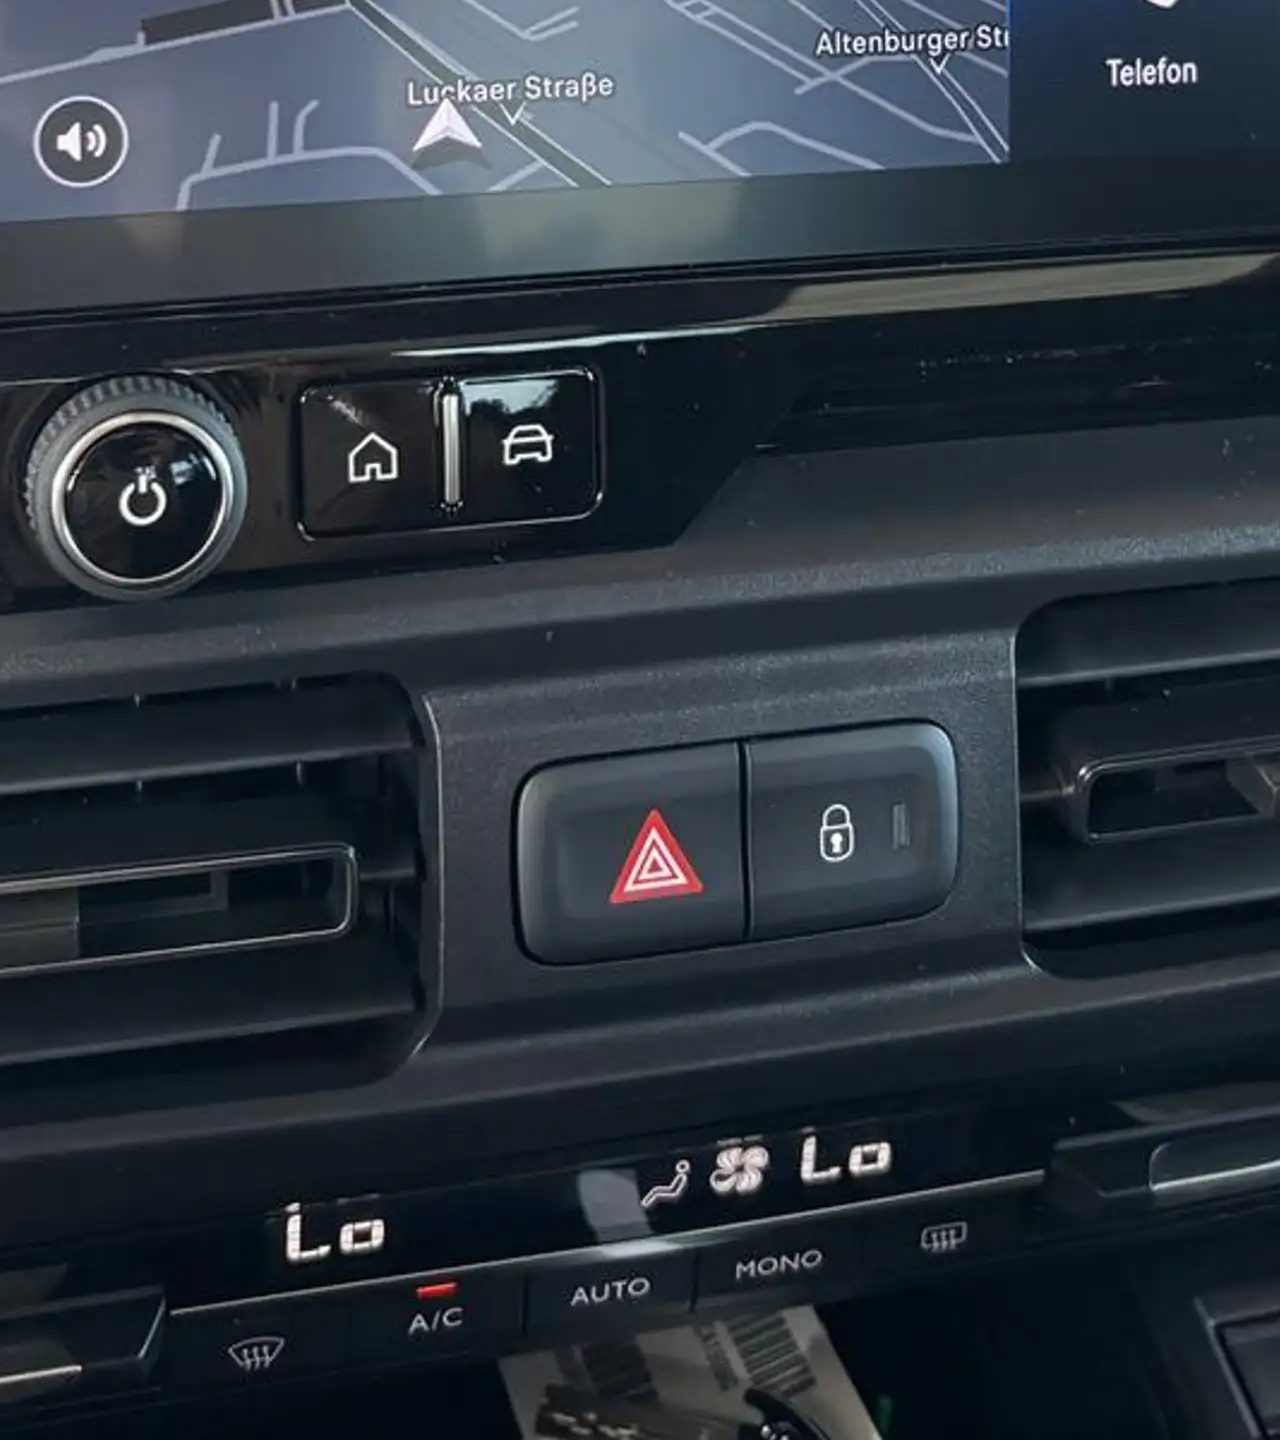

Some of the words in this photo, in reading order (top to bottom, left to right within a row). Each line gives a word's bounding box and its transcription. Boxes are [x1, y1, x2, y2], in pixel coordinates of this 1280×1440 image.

[816, 28, 969, 56] Altenburger
[1106, 57, 1198, 87] Telefon
[407, 76, 516, 106] Luckaer
[523, 73, 614, 102] Straße
[801, 1133, 893, 1185] Lo
[285, 1207, 385, 1264] Lo
[735, 1249, 824, 1280] MONO
[570, 1276, 651, 1307] AUTO
[408, 1306, 464, 1336] A/C
